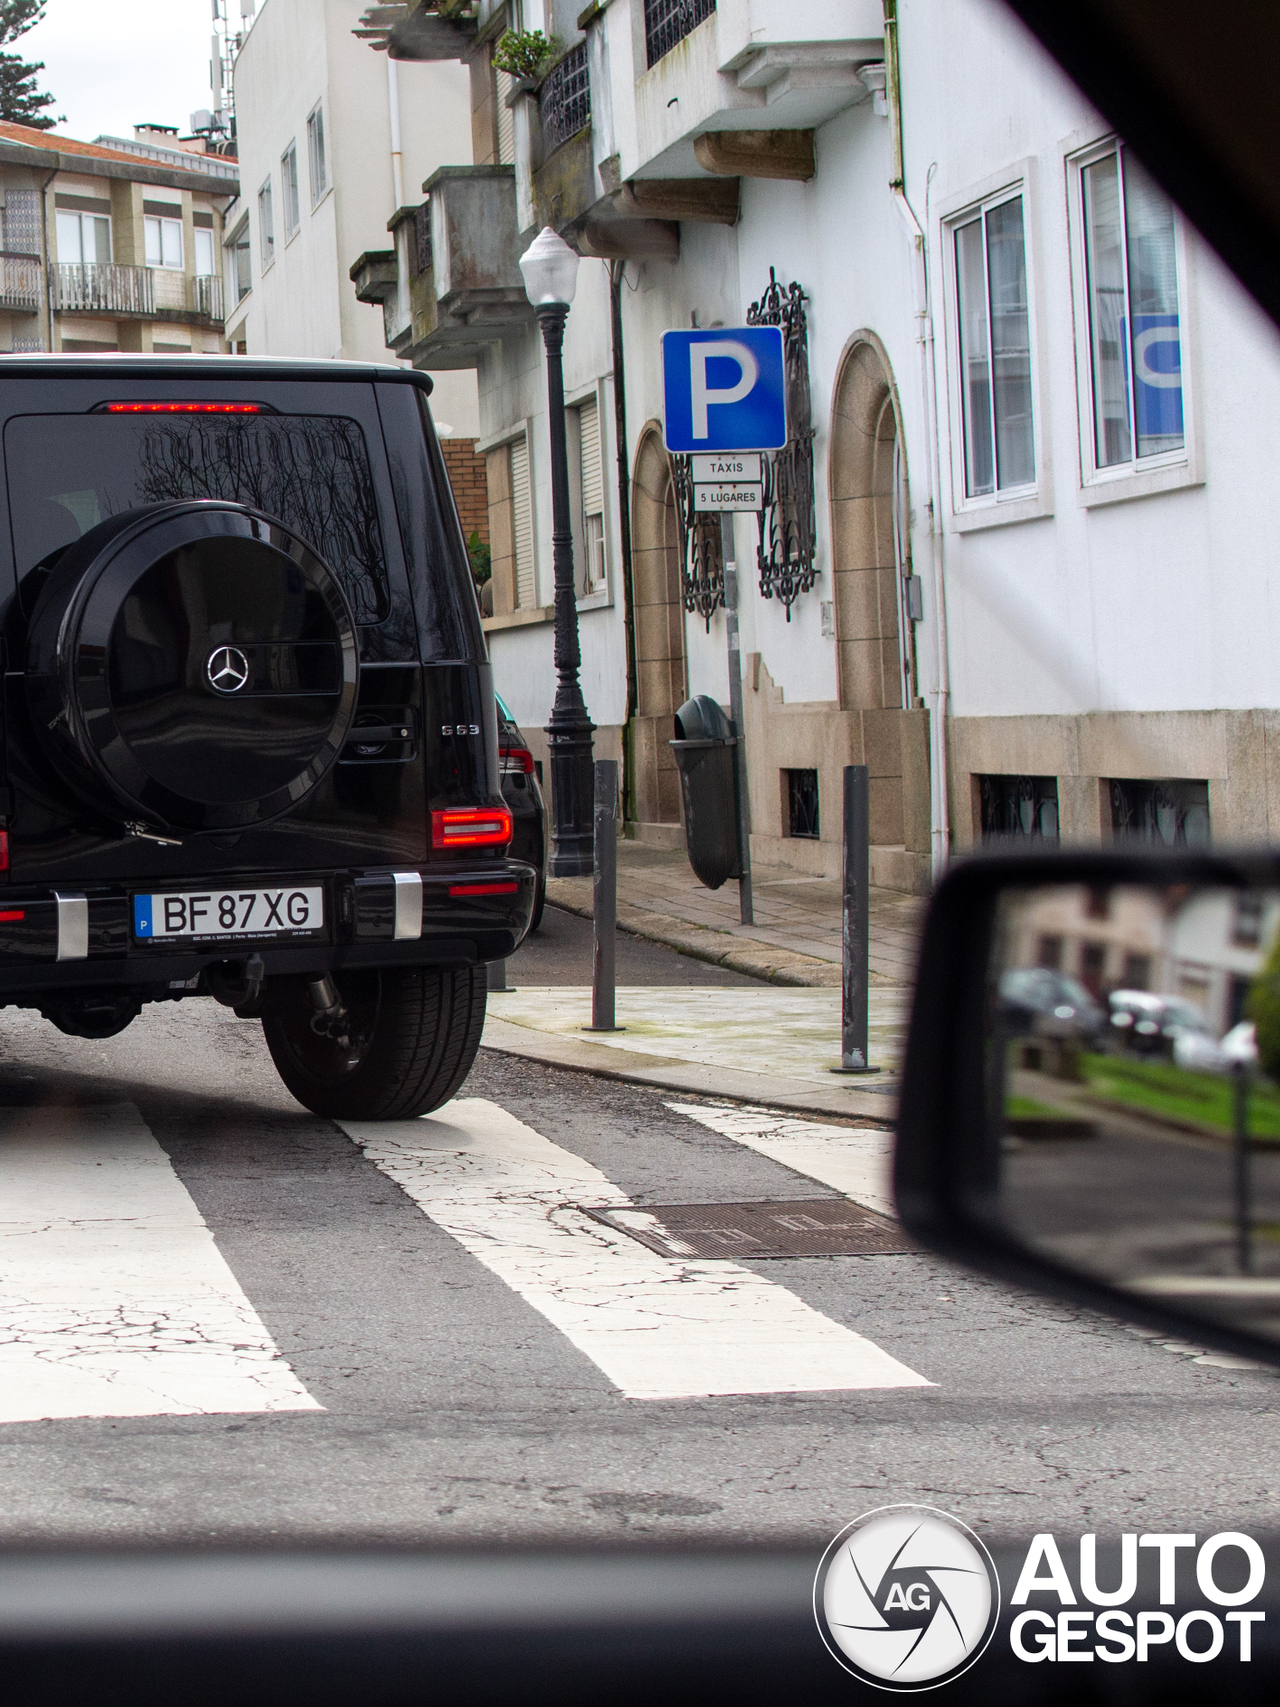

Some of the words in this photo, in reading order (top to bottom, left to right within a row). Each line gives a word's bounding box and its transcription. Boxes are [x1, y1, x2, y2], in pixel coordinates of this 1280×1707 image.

[689, 340, 758, 440] P
[710, 463, 743, 473] TAXIS
[701, 493, 706, 502] 5
[711, 493, 756, 502] LUGARES
[441, 725, 453, 736] G
[456, 724, 480, 736] 63
[163, 896, 211, 932] BF
[218, 894, 256, 929] 87
[263, 892, 309, 927] XG
[140, 920, 148, 930] P
